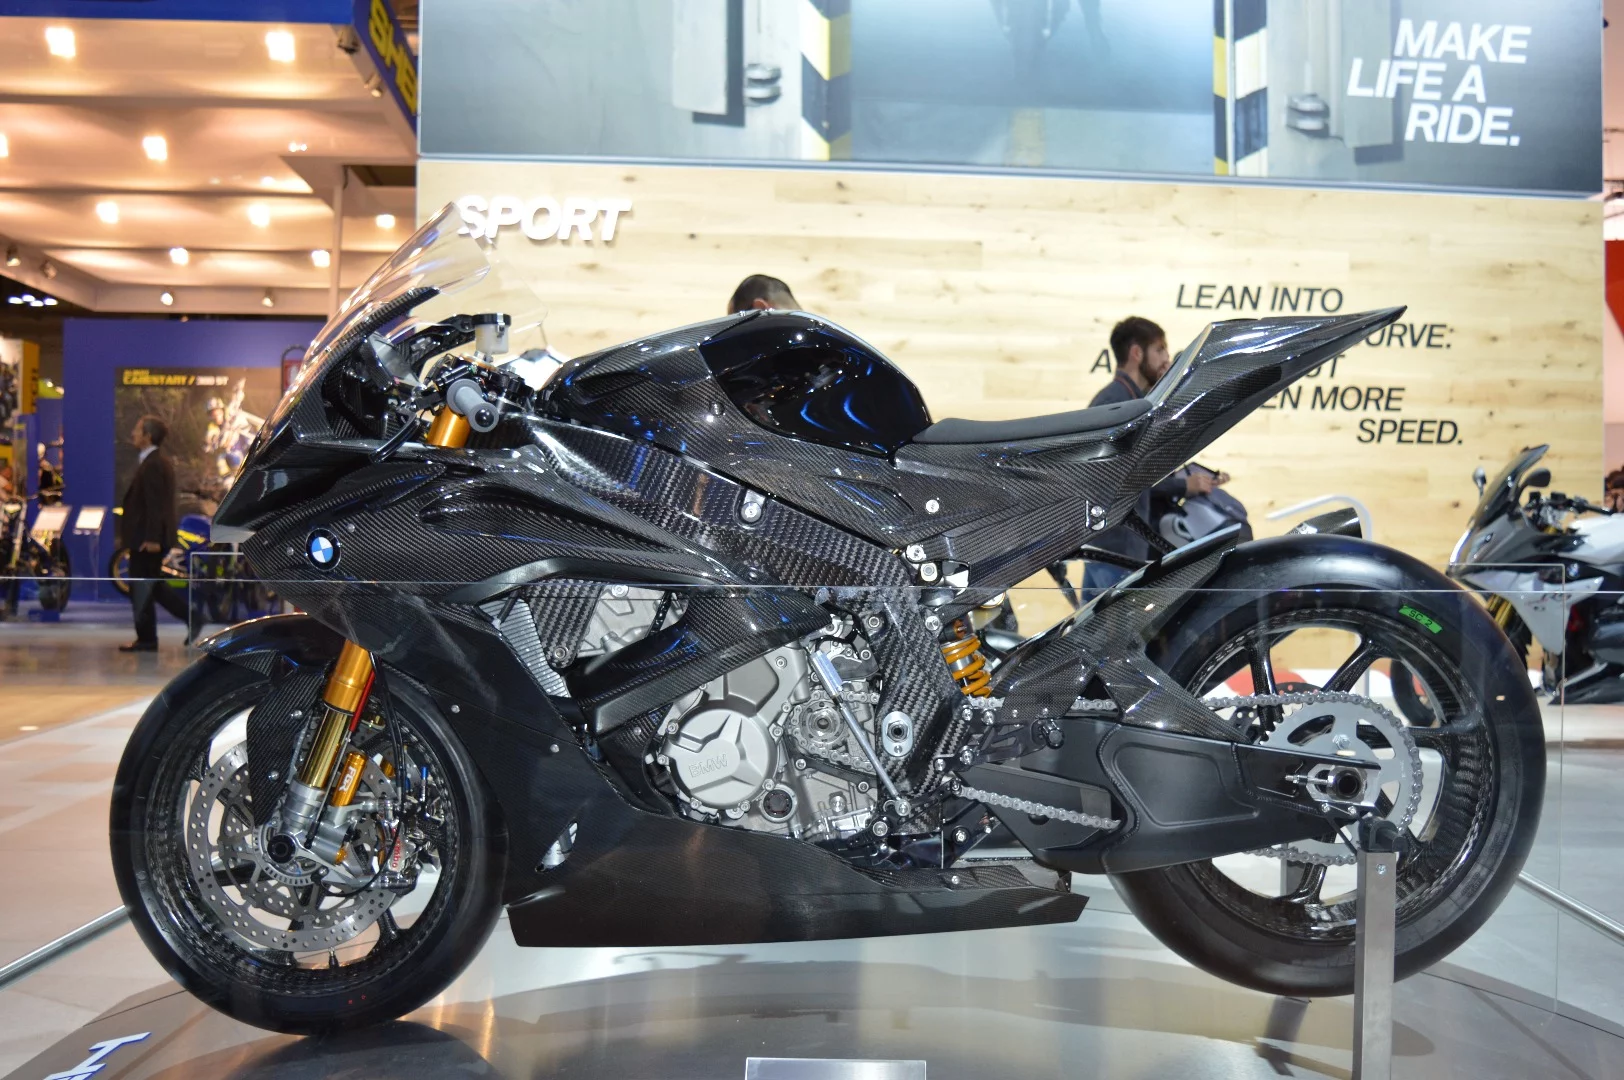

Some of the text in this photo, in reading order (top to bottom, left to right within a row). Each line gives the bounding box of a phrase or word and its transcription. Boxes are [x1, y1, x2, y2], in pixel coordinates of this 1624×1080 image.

[1393, 18, 1532, 64] MAKE
[1346, 57, 1486, 103] LIFE A
[1404, 102, 1520, 146] RIDE.
[457, 194, 633, 241] SPORT
[1176, 284, 1344, 312] LEAN INTO
[1311, 386, 1406, 411] MORE
[1356, 418, 1463, 444] SPEED.
[338, 765, 357, 792] FGR
[688, 753, 728, 779] BMW
